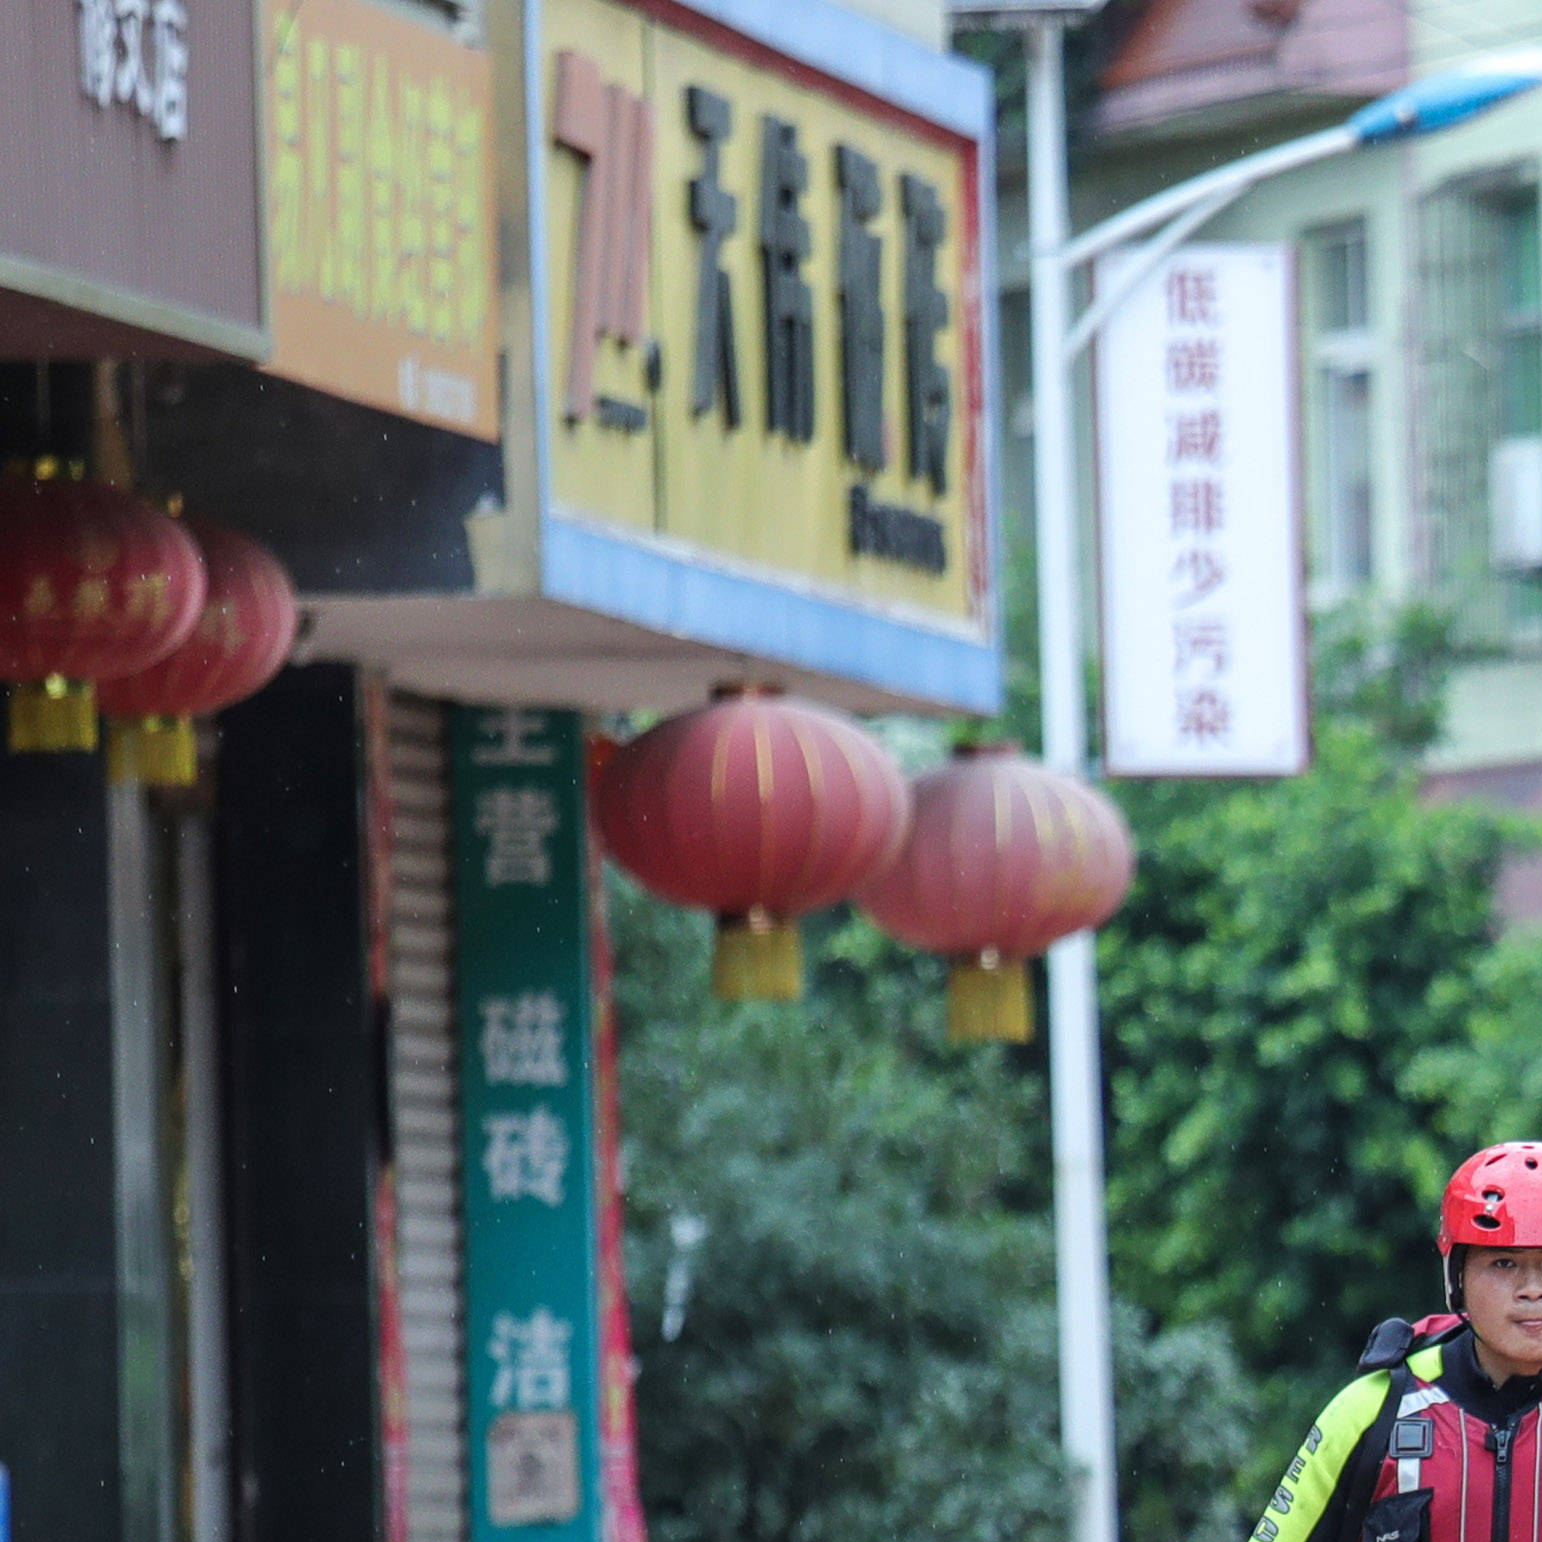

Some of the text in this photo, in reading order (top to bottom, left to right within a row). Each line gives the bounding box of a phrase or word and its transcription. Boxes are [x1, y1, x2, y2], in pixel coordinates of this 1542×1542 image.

[1166, 268, 1231, 746] 低碳减排少污染
[471, 709, 560, 886] 主营
[479, 986, 567, 1206] 磁砖
